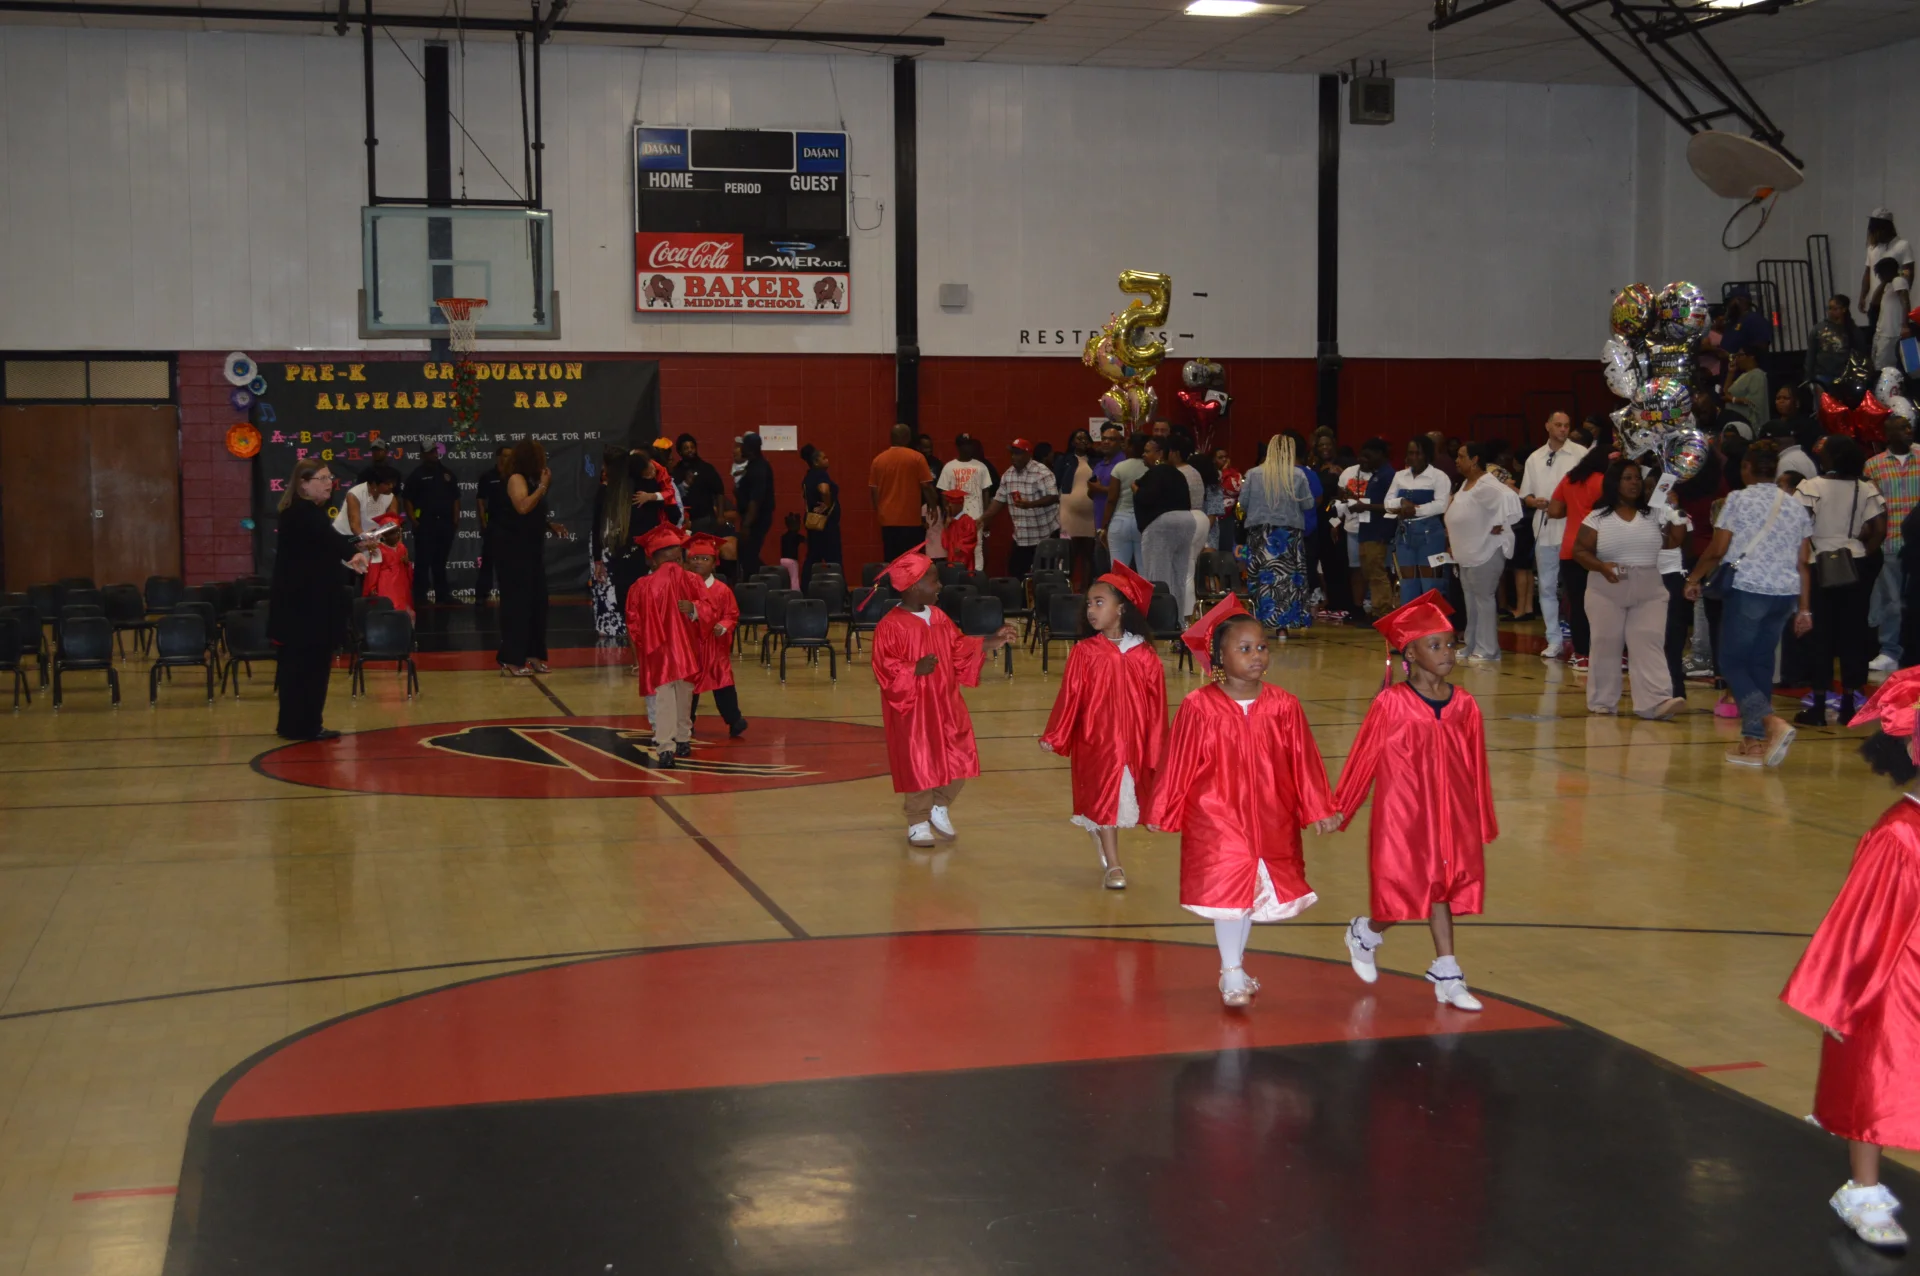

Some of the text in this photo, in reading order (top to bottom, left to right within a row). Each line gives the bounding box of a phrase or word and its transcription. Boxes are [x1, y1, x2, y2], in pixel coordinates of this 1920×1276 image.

[642, 143, 682, 155] DASANI
[803, 147, 839, 159] DASANI
[649, 172, 694, 188] HOME
[790, 175, 838, 191] GUEST
[724, 182, 762, 194] PERIOD
[649, 240, 734, 269] Coca-Cola
[684, 276, 804, 298] BAKER
[684, 298, 805, 309] MIDDLE SCHOOL
[1020, 330, 1168, 344] RESTRS
[285, 362, 583, 382] PRE-K GRDUATION
[513, 391, 568, 409] RAP
[391, 434, 461, 443] KINDERGARTEN
[495, 433, 507, 442] BE
[532, 432, 558, 441] PLACE
[562, 432, 580, 440] FOR
[407, 452, 420, 460] WE
[470, 451, 493, 460] BEST
